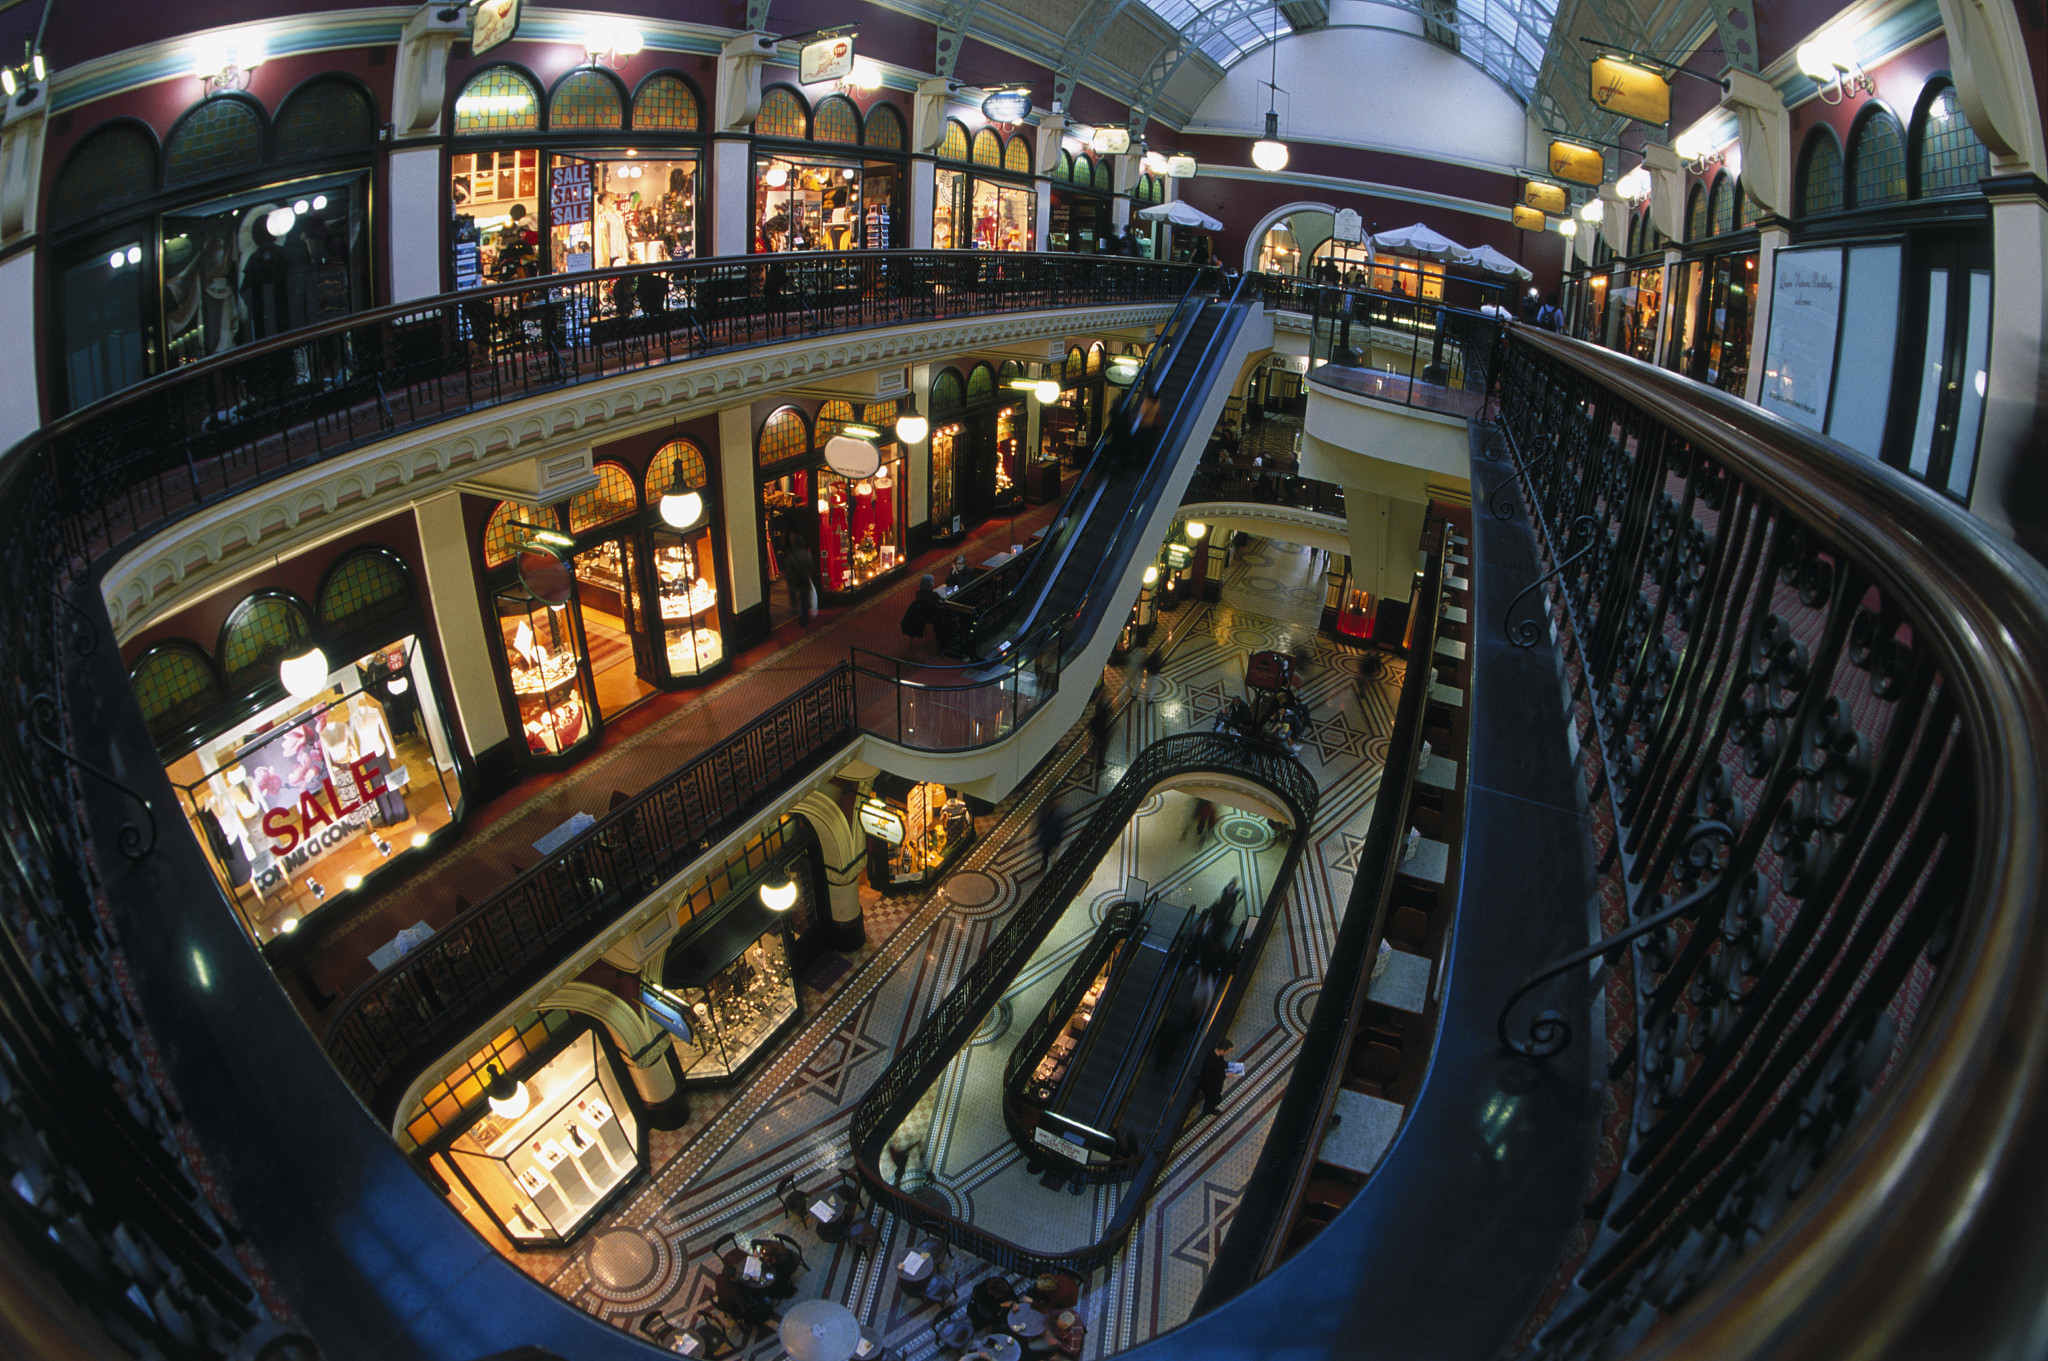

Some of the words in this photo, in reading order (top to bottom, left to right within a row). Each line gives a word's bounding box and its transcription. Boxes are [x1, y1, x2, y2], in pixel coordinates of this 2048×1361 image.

[553, 164, 590, 186] SALE
[553, 184, 590, 206] SALE
[553, 204, 590, 226] SALE
[262, 751, 388, 856] SALE
